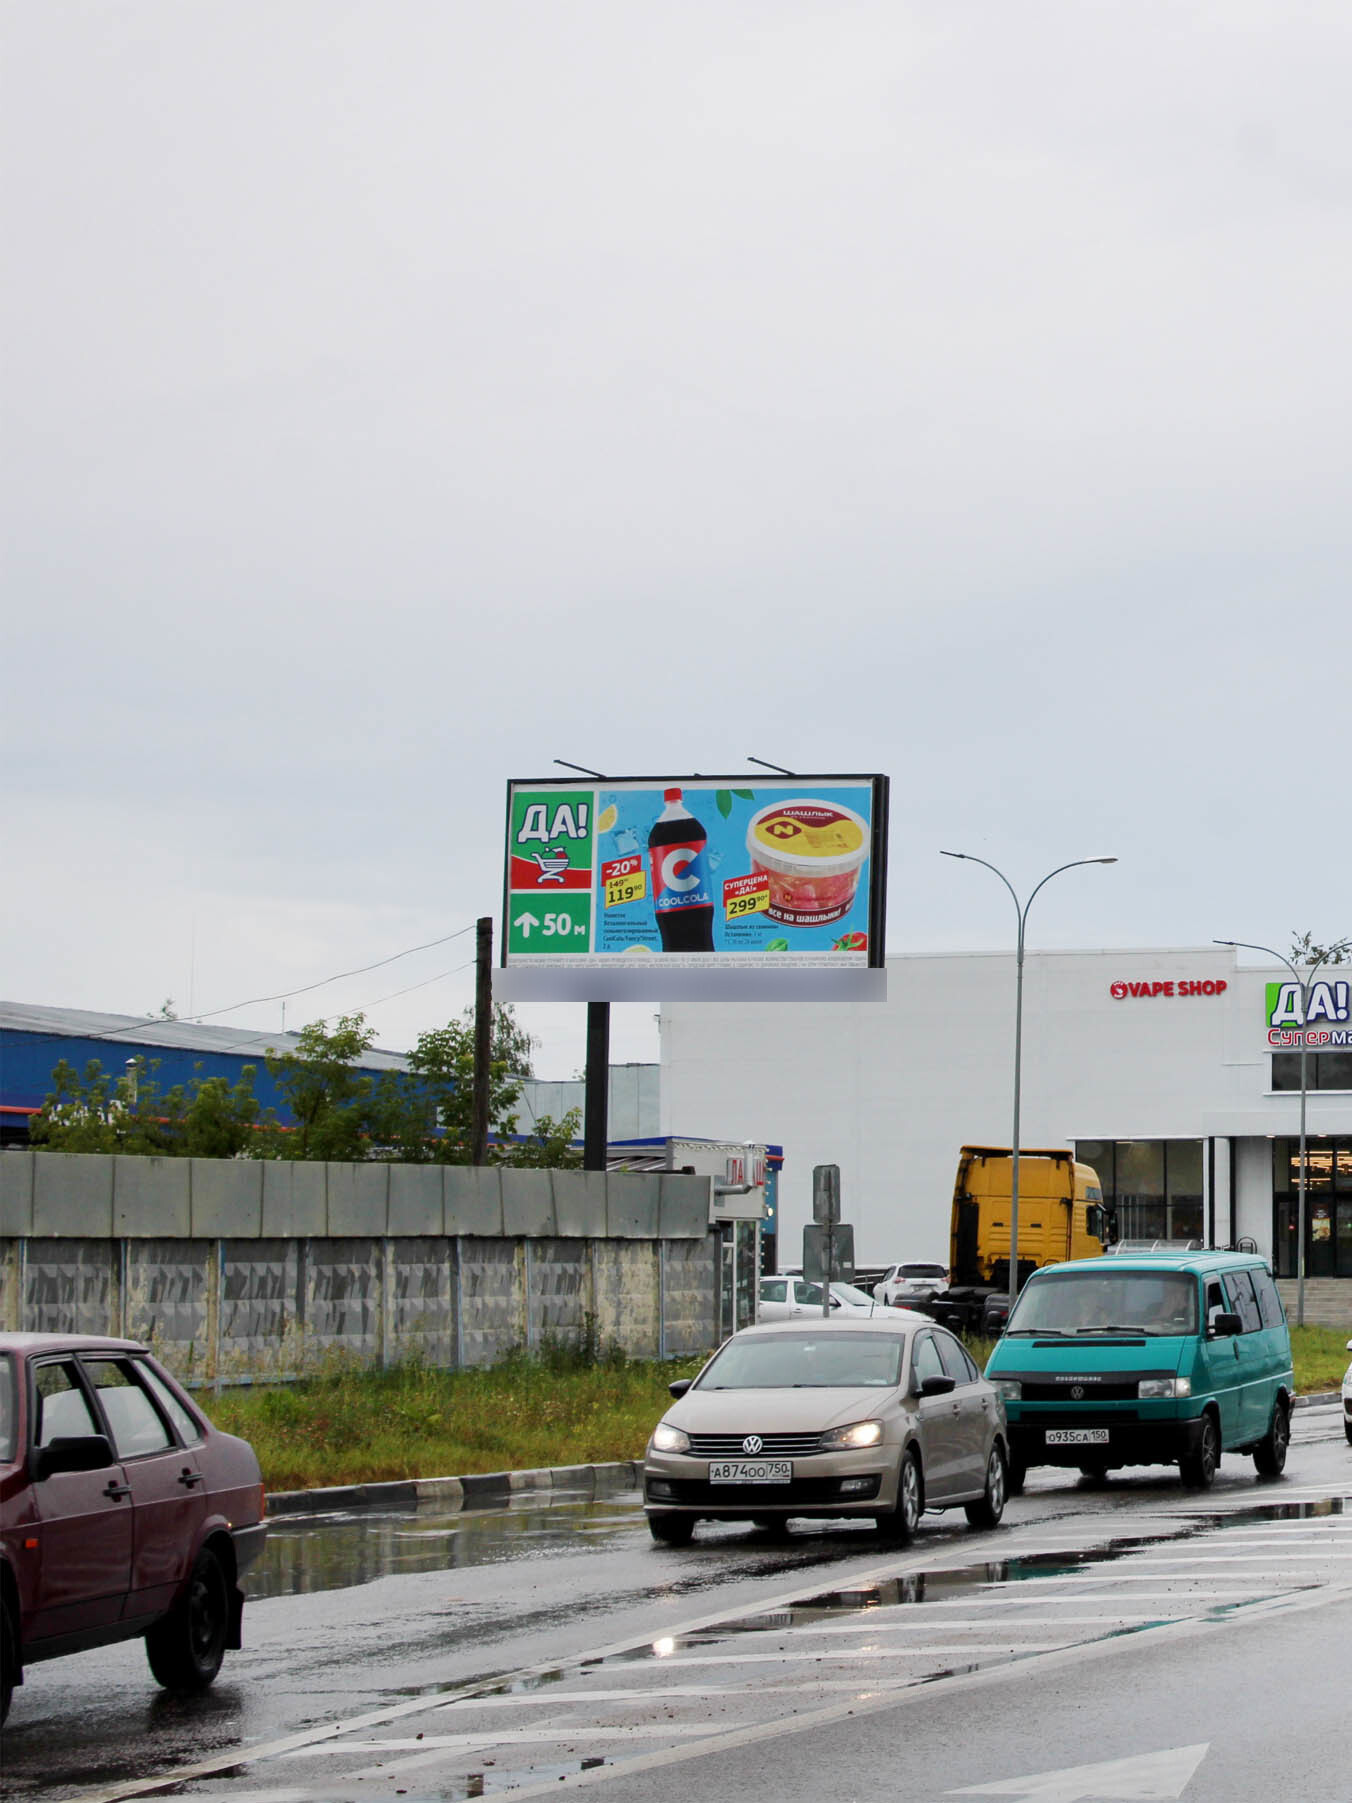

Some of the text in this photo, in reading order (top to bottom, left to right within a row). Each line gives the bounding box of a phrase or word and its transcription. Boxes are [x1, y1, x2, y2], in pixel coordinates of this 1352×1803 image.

[517, 803, 589, 843] ДА!
[724, 874, 768, 890] СУПЕРЦЕНА
[658, 893, 709, 907] COOLCOLA
[542, 912, 572, 936] 50
[783, 912, 794, 921] на
[1128, 979, 1228, 998] VAPE SHOP
[1270, 982, 1350, 1027] ДА!
